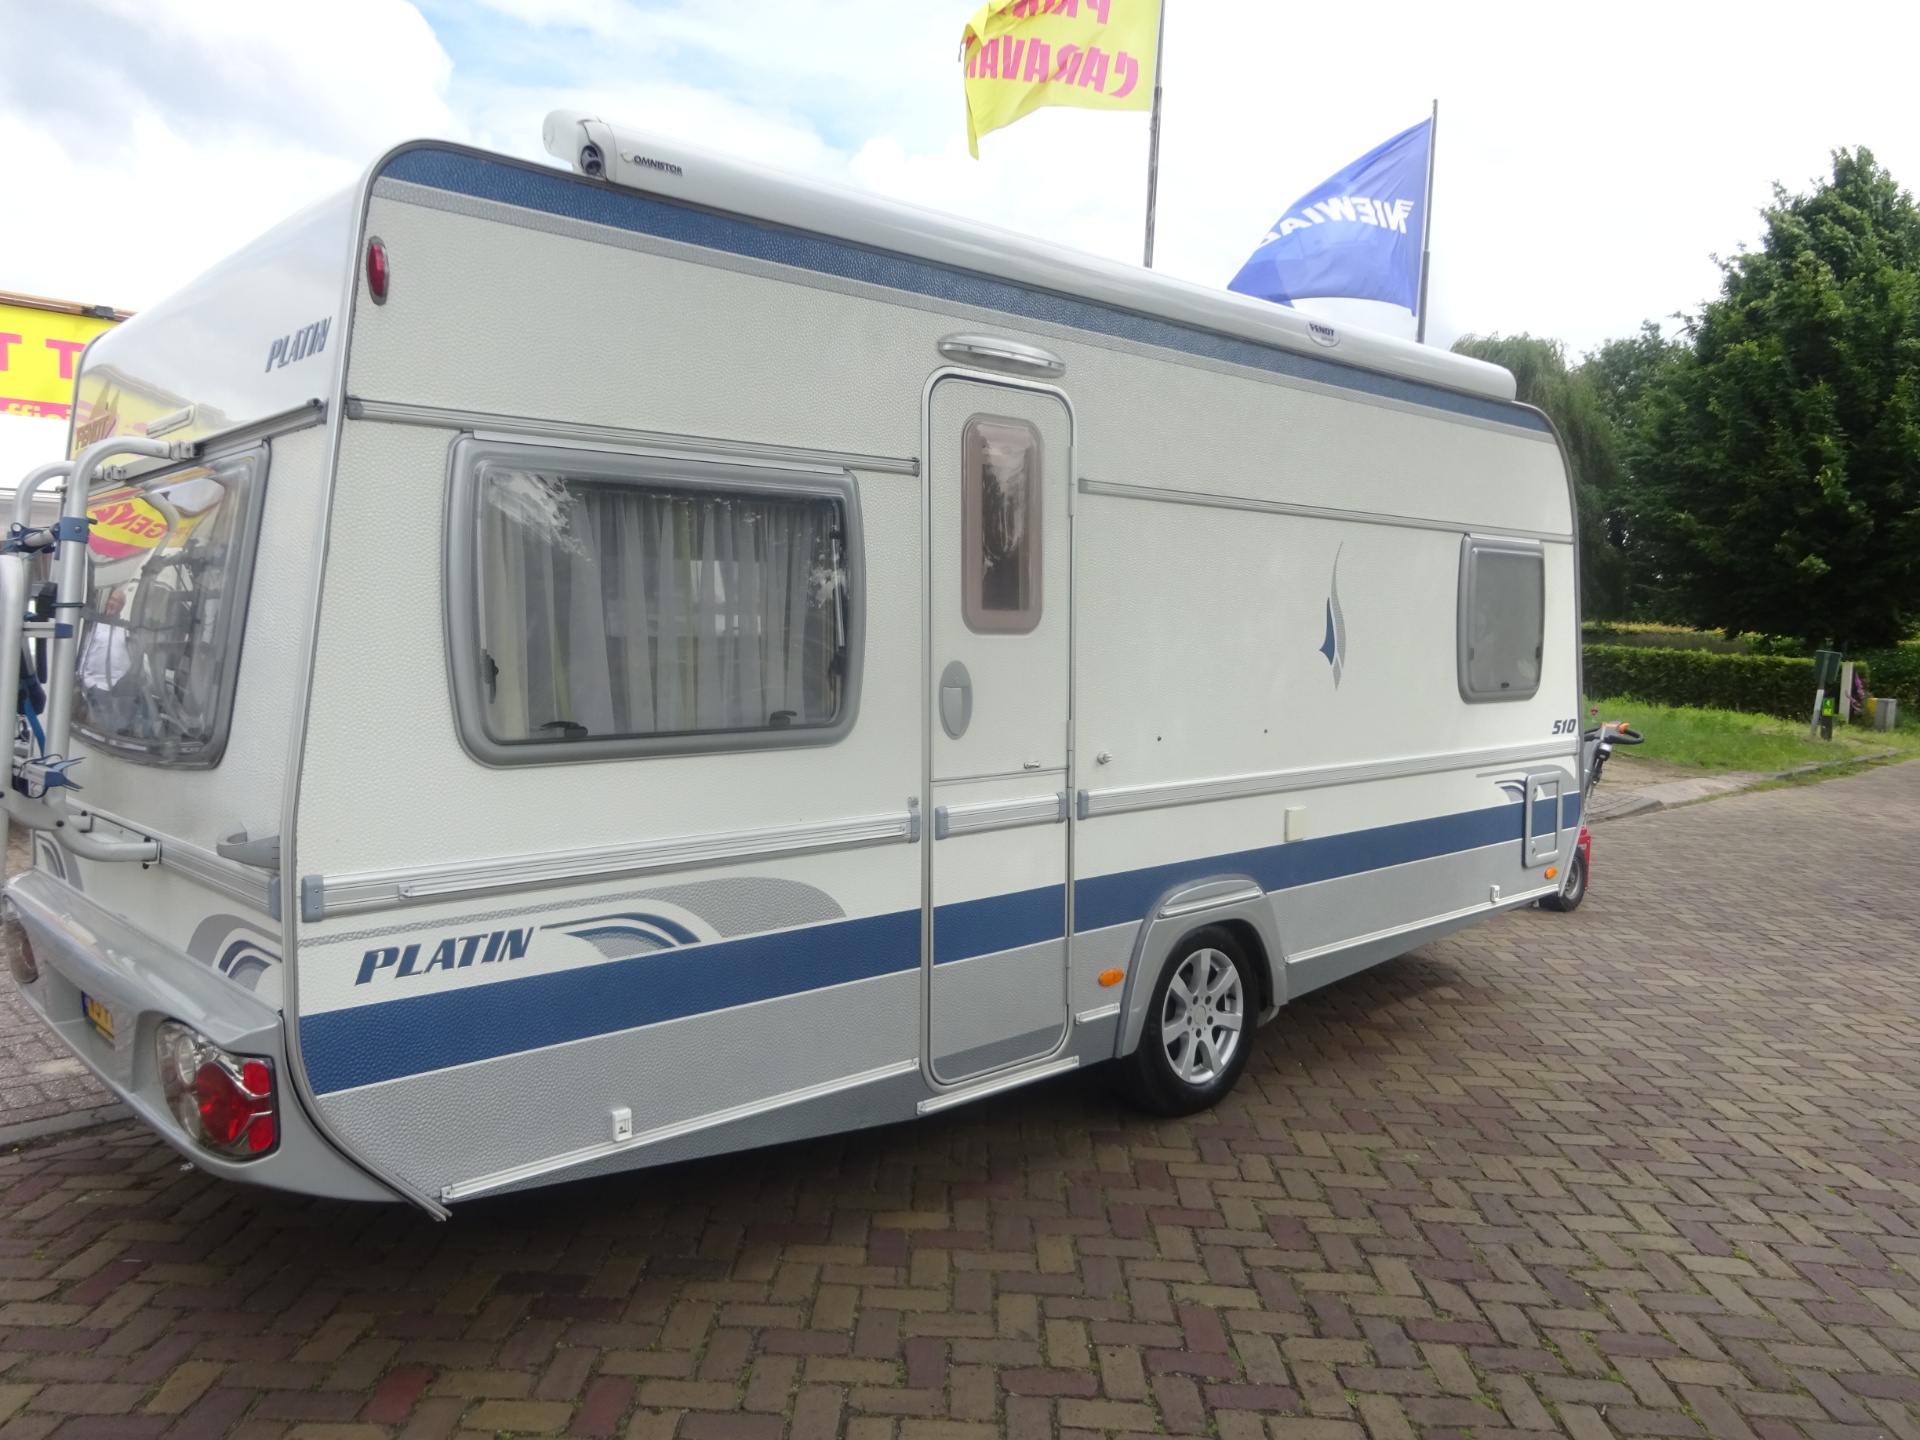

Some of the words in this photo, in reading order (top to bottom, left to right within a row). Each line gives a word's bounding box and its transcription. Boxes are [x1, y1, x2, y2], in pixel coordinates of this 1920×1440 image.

[633, 155, 683, 176] OMNISTOR
[265, 316, 332, 373] PLATIN
[1552, 718, 1577, 735] 510
[354, 927, 534, 986] PLATIN
